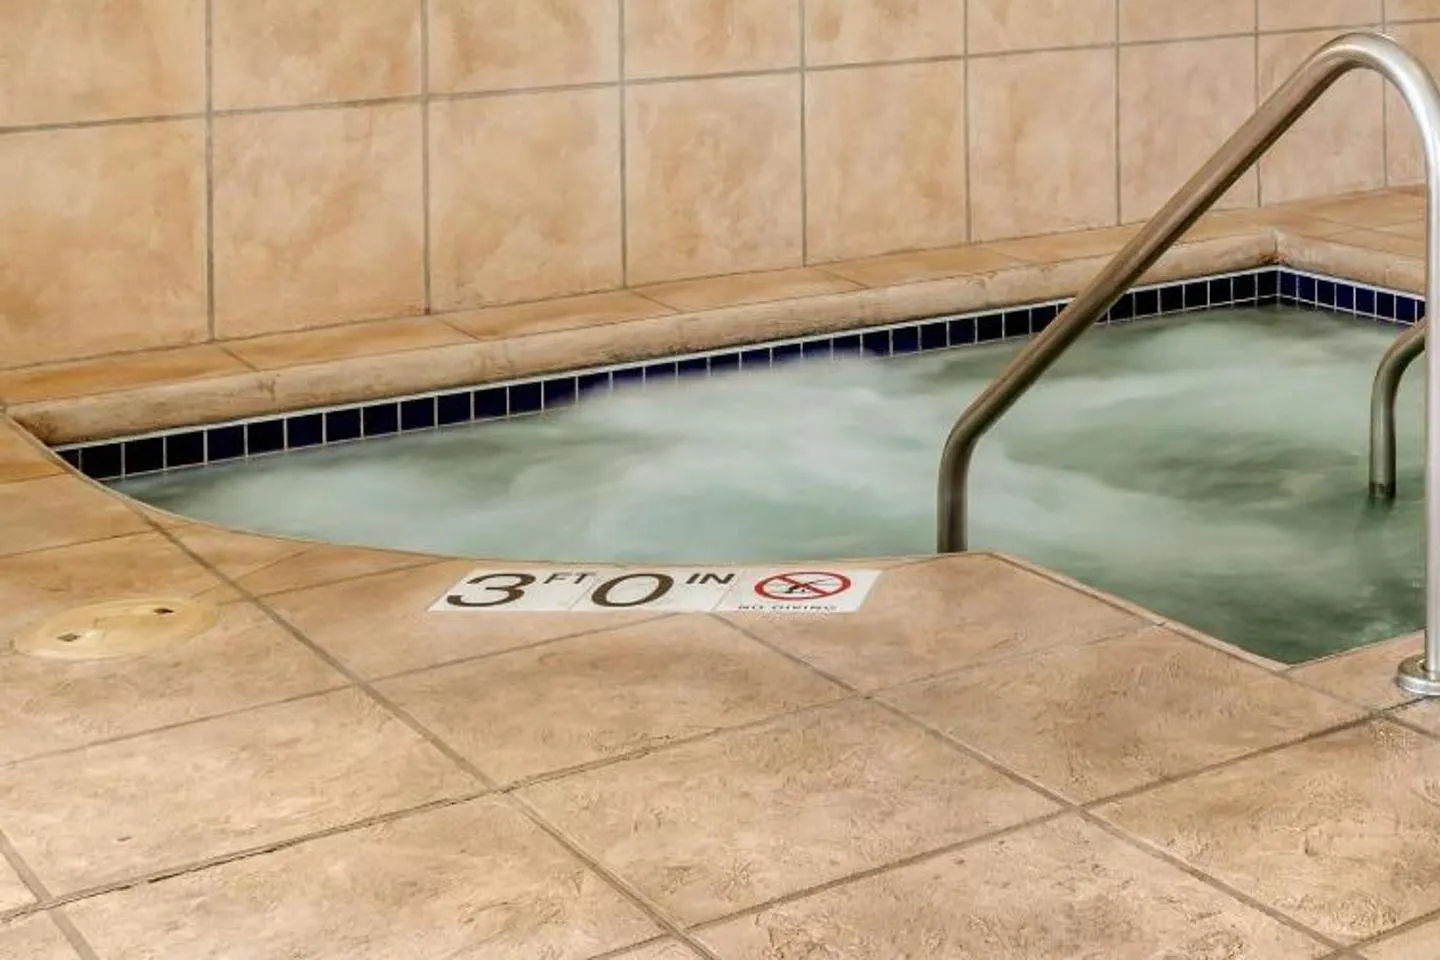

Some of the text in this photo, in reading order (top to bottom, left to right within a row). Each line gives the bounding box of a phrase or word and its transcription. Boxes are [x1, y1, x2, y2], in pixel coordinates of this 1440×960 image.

[446, 572, 736, 608] 3 FT 0 IN
